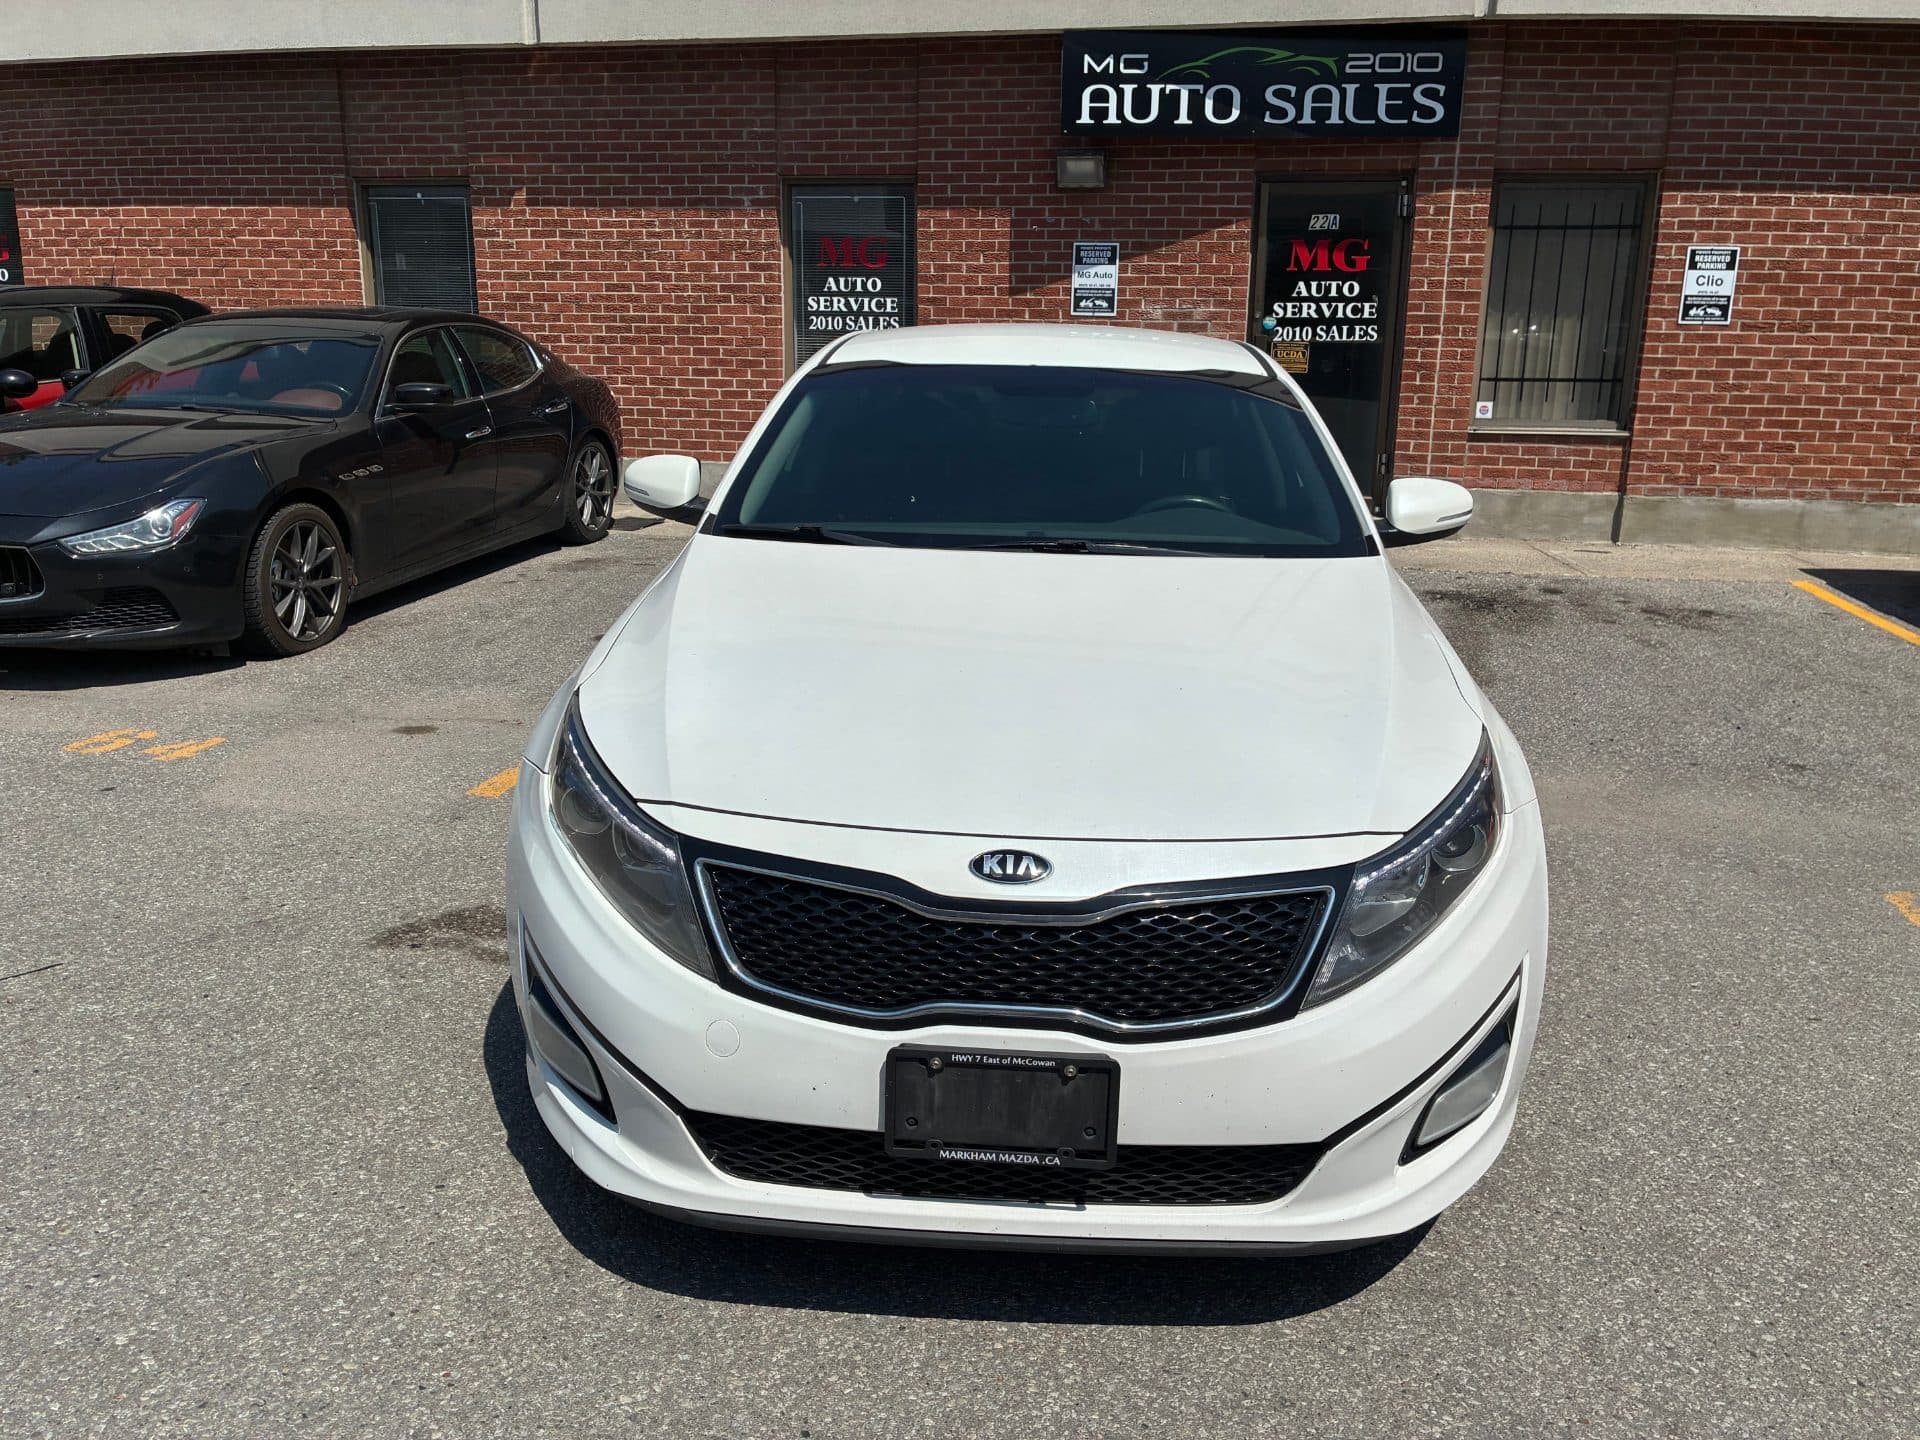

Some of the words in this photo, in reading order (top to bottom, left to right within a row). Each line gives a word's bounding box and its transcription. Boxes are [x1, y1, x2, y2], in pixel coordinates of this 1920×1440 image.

[1083, 53, 1149, 74] MG
[1345, 52, 1443, 73] 2010
[1076, 83, 1241, 124] AUTO
[1263, 83, 1445, 124] SALES
[1310, 214, 1339, 230] 22A
[817, 236, 889, 269] MG
[1080, 250, 1112, 258] RESERVED
[1286, 238, 1370, 272] MG
[1695, 254, 1731, 263] RESERVED
[1082, 257, 1109, 265] PARKING
[1696, 262, 1727, 270] PARKING
[1077, 271, 1091, 279] MG
[1093, 271, 1113, 279] Auto
[1696, 274, 1724, 287] Clio
[823, 276, 881, 292] AUTO
[1292, 281, 1360, 297] AUTO
[807, 296, 898, 313] SERVICE
[1272, 302, 1378, 319] SERVICE
[809, 315, 843, 330] 2010
[845, 315, 900, 331] SALES
[1273, 326, 1312, 342] 2010
[1315, 325, 1378, 341] SALES
[1277, 350, 1304, 359] UCDA
[983, 854, 1039, 876] KIA
[951, 1054, 973, 1063] HWY
[975, 1055, 981, 1063] 7
[983, 1055, 1000, 1064] East
[1002, 1057, 1011, 1065] of
[1012, 1057, 1056, 1067] McCowan
[939, 1150, 996, 1162] MARKHAM
[999, 1153, 1039, 1164] MAZDA
